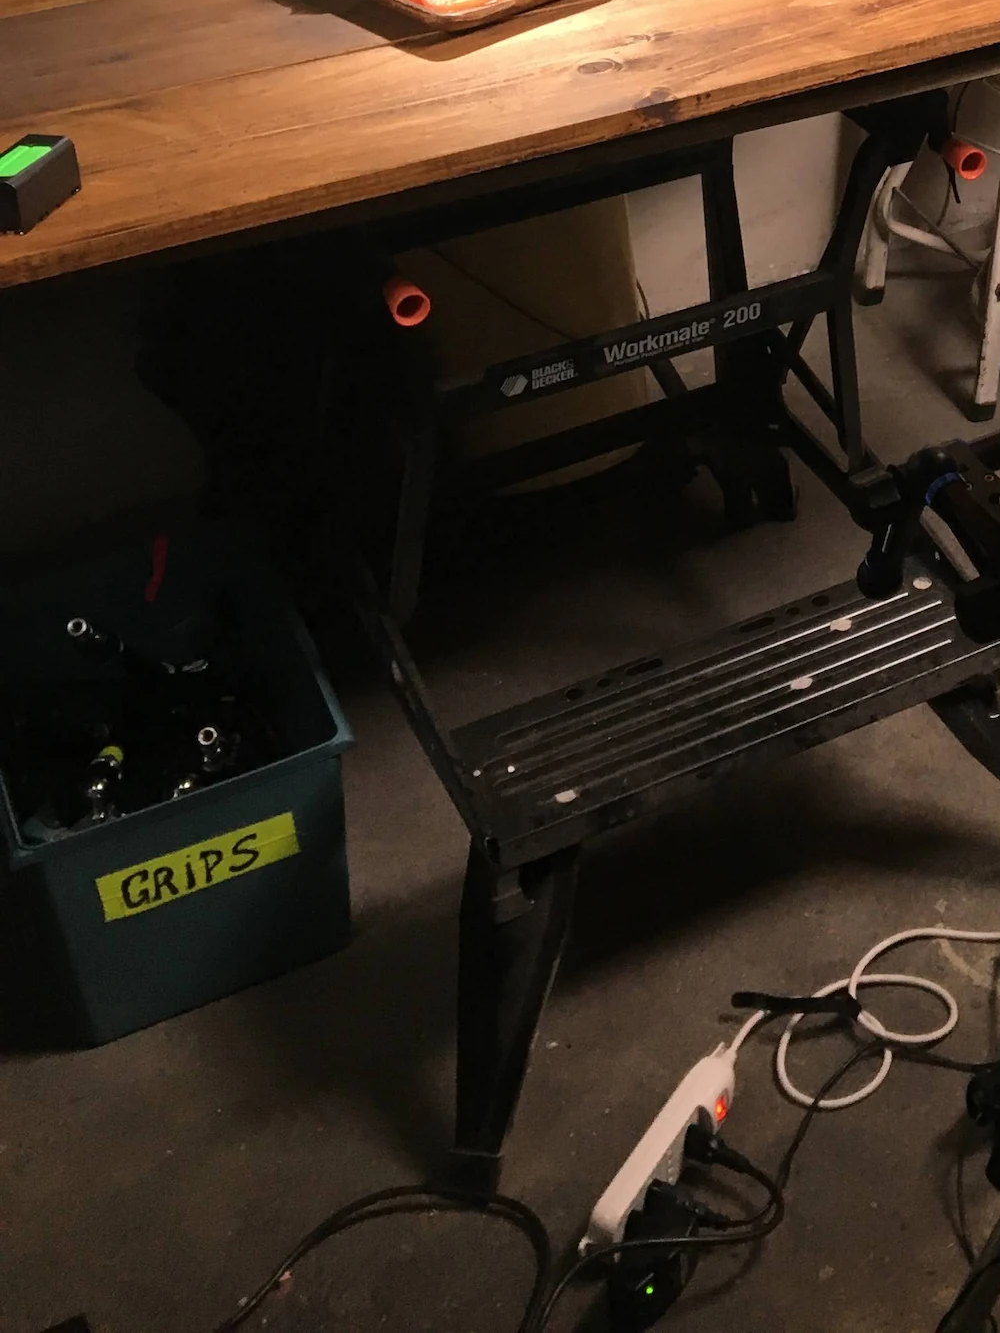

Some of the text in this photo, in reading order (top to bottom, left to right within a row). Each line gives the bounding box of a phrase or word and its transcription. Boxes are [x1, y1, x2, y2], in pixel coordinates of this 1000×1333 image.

[603, 302, 761, 364] Workmate 200
[531, 369, 575, 390] DECKER
